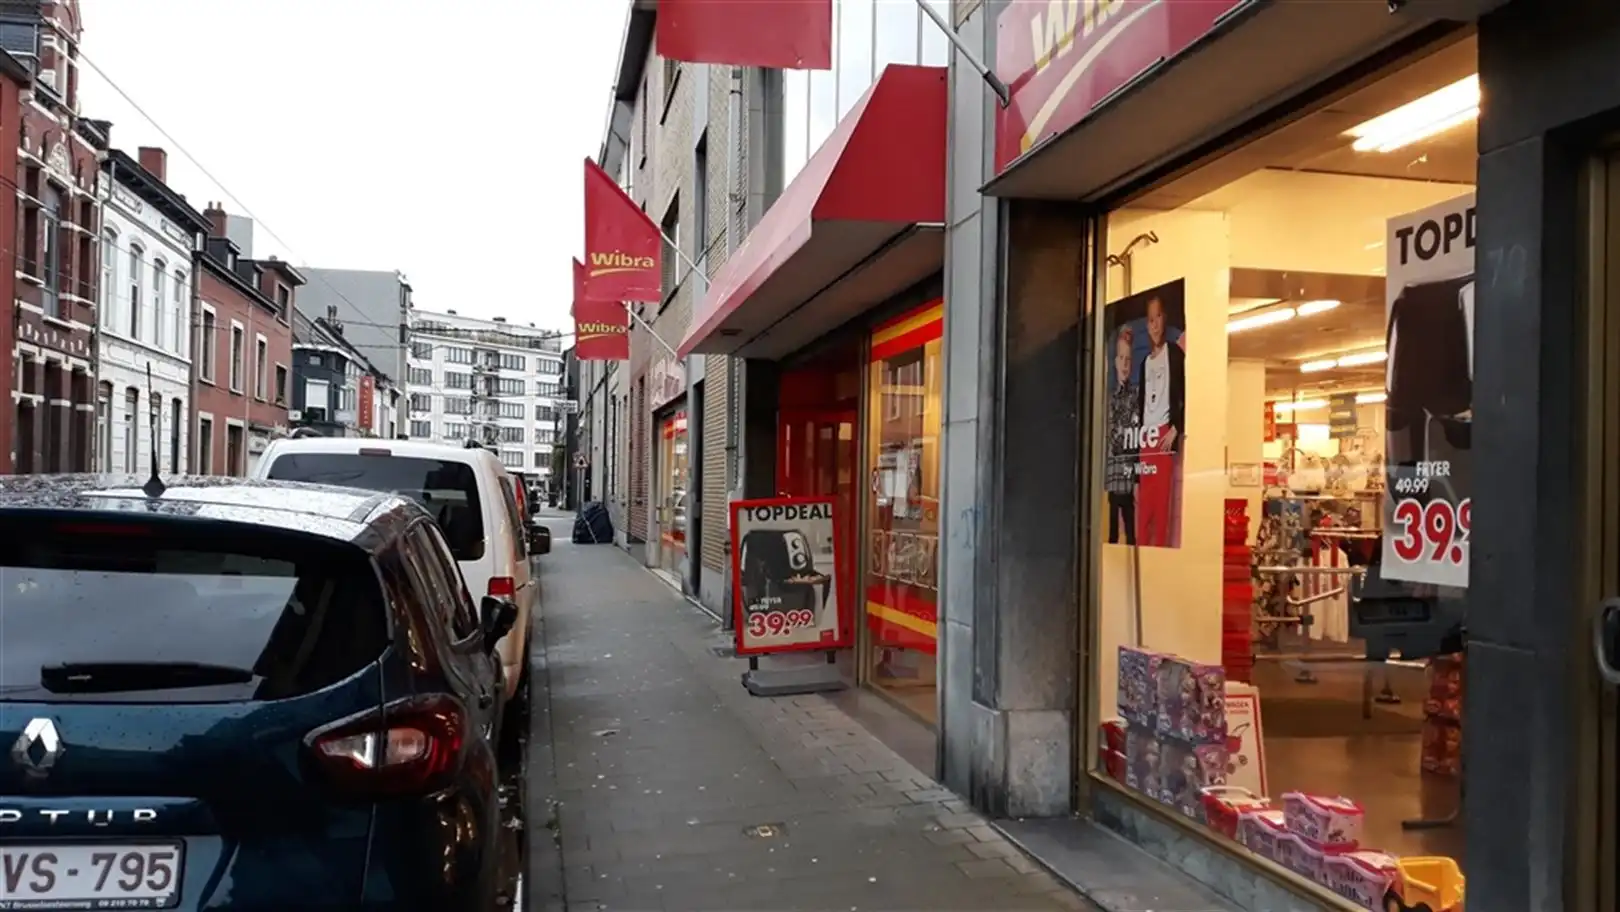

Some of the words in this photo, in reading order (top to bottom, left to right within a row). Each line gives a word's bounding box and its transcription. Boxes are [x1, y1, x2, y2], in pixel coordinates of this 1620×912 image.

[591, 250, 655, 268] Wibra
[578, 320, 626, 333] Wibra
[1123, 418, 1159, 449] nice
[1416, 461, 1450, 476] FRYER
[1395, 478, 1428, 493] 49.99
[743, 504, 832, 522] TOPDEAL
[748, 609, 813, 638] 39.99
